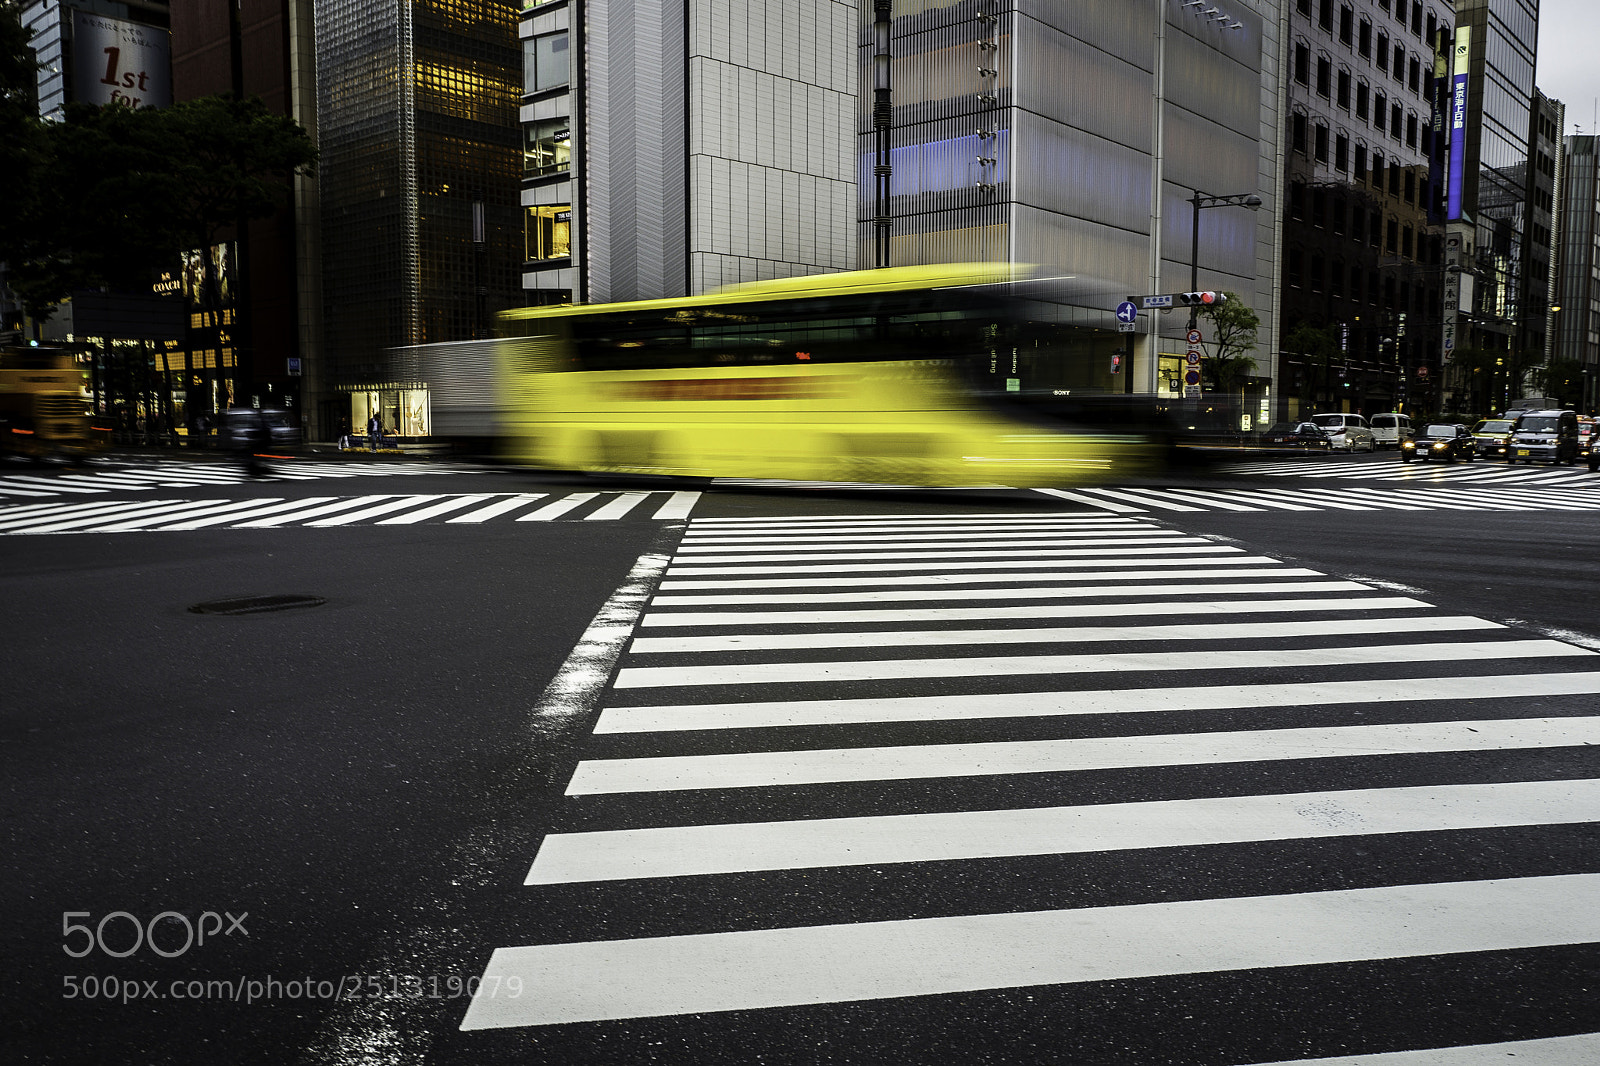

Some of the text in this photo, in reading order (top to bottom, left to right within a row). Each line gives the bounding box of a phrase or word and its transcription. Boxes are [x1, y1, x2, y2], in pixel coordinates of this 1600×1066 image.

[100, 46, 150, 92] 1st
[110, 90, 141, 109] for
[1453, 82, 1465, 130] 東京海上日動
